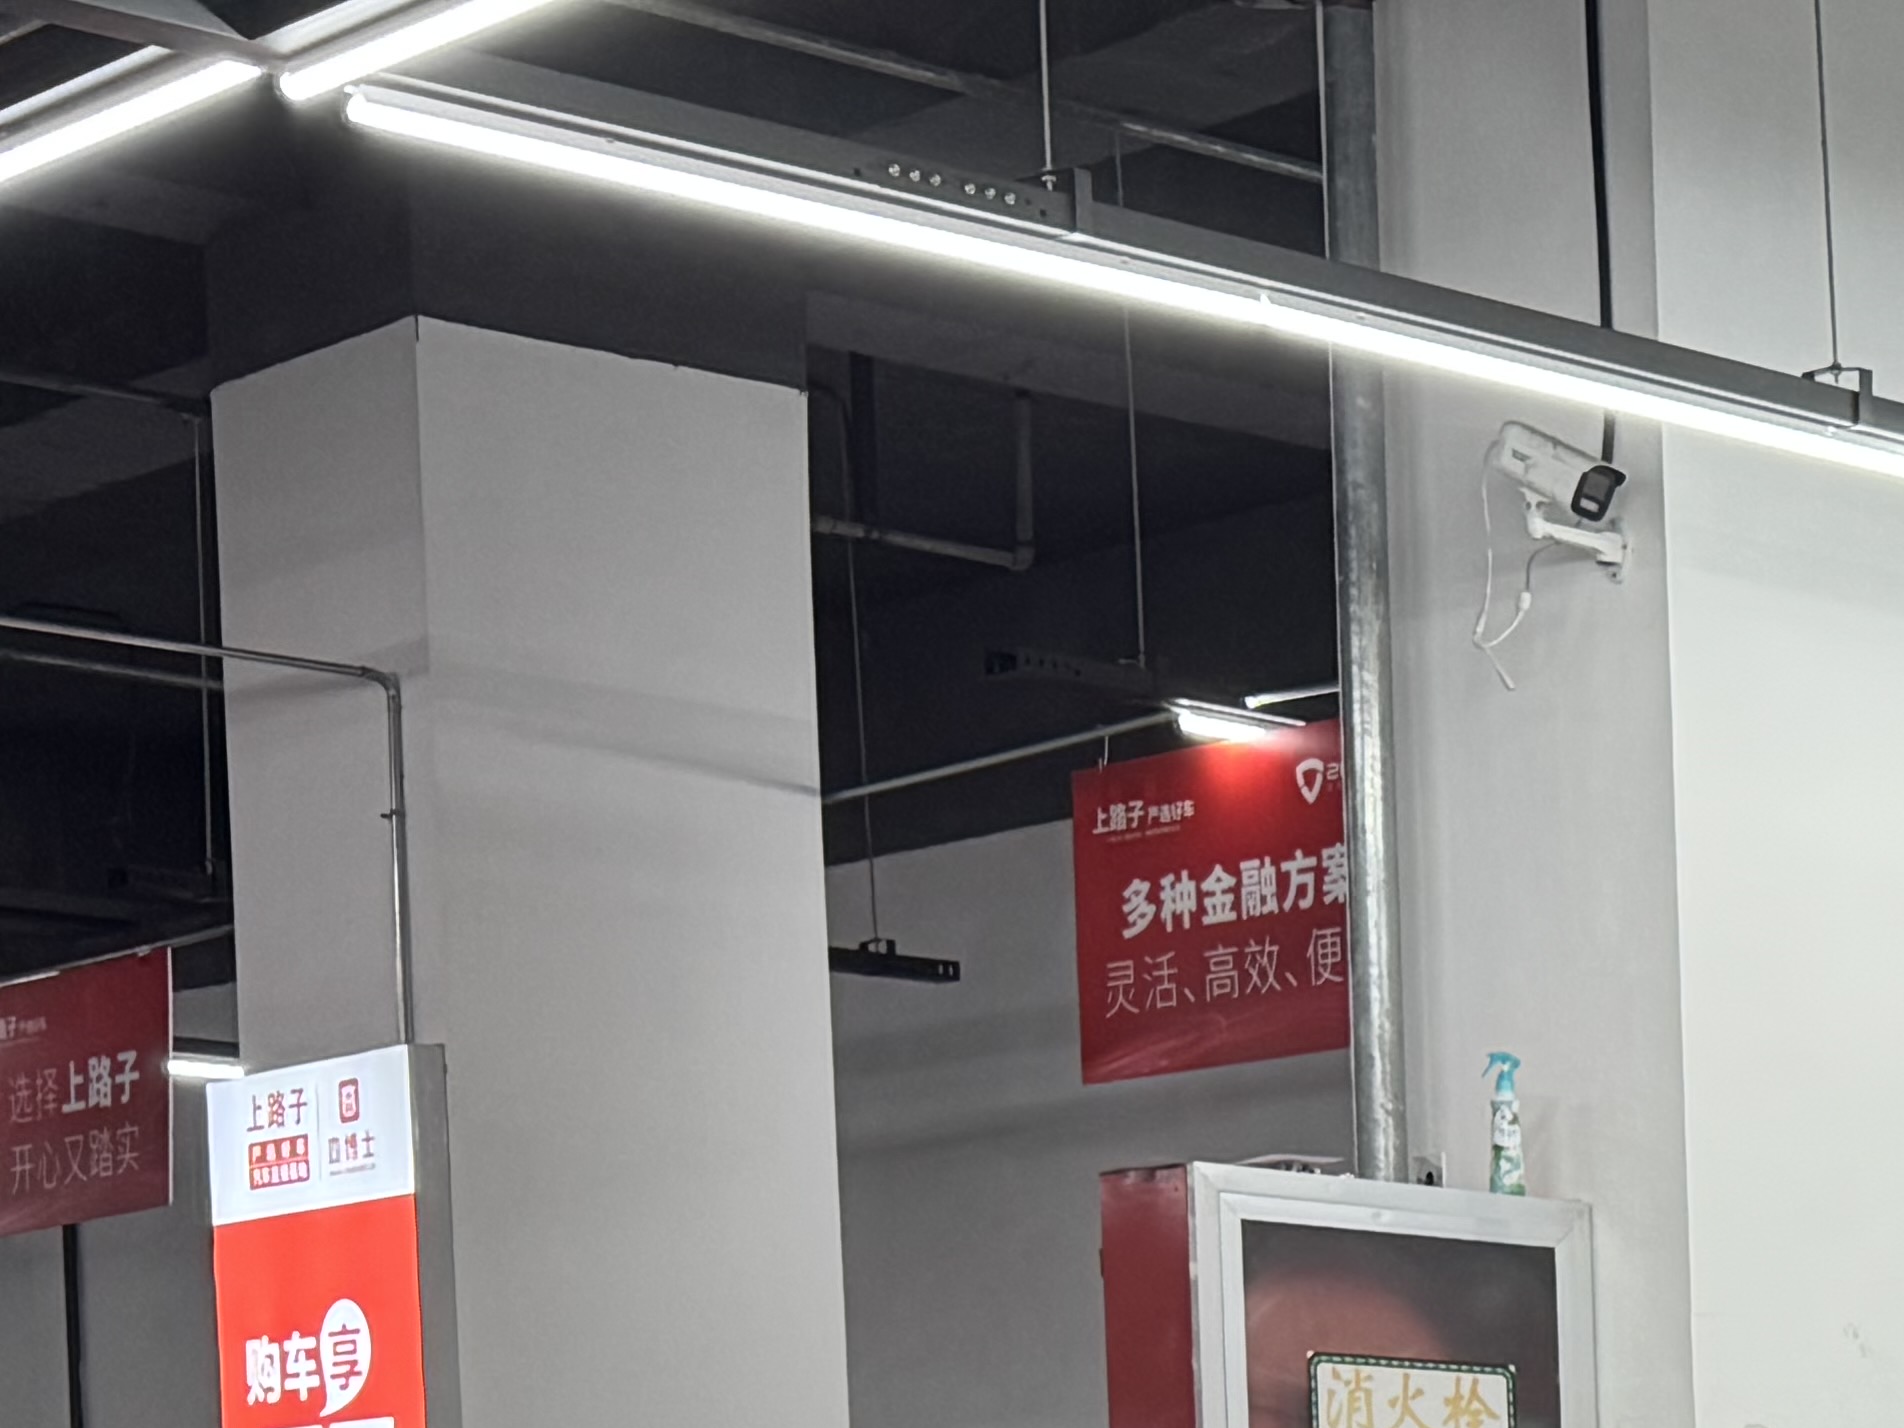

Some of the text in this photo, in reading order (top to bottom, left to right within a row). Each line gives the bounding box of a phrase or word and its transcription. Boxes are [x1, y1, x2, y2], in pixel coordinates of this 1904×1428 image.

[1092, 800, 1145, 835] 上路子
[1121, 842, 1347, 940] 多种金融方案
[1105, 926, 1344, 1019] 灵活、高效、便
[8, 1050, 141, 1124] 选择上路子
[246, 1087, 309, 1133] 上路子
[9, 1120, 140, 1196] 开心又踏实
[245, 1322, 363, 1406] 购车享
